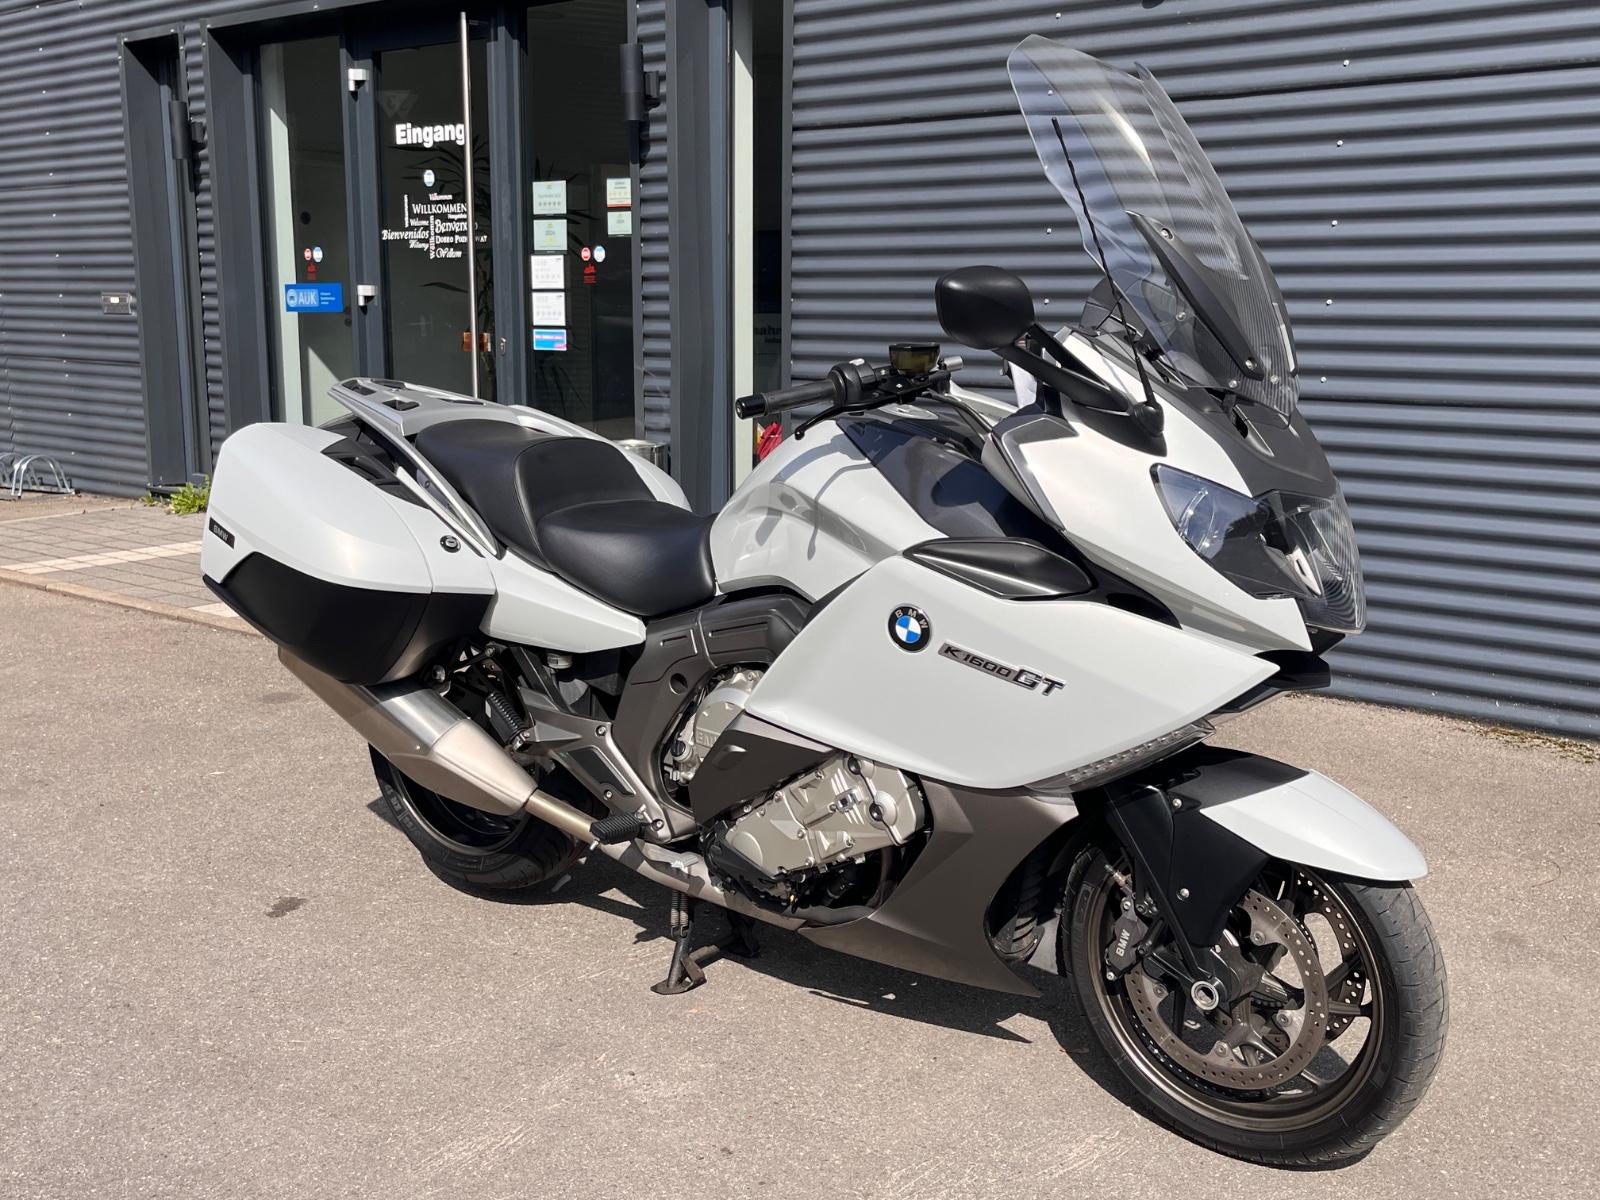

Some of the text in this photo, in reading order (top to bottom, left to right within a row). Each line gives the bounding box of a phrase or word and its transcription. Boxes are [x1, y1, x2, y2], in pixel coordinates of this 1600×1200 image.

[395, 123, 465, 148] Eingang
[411, 203, 467, 215] WILLKOMMEN
[381, 227, 429, 240] Bienvenidos
[298, 292, 317, 305] AUK
[213, 524, 229, 541] BMW
[895, 608, 929, 630] BMW
[1012, 668, 1066, 698] GT
[1115, 929, 1131, 957] BMW
